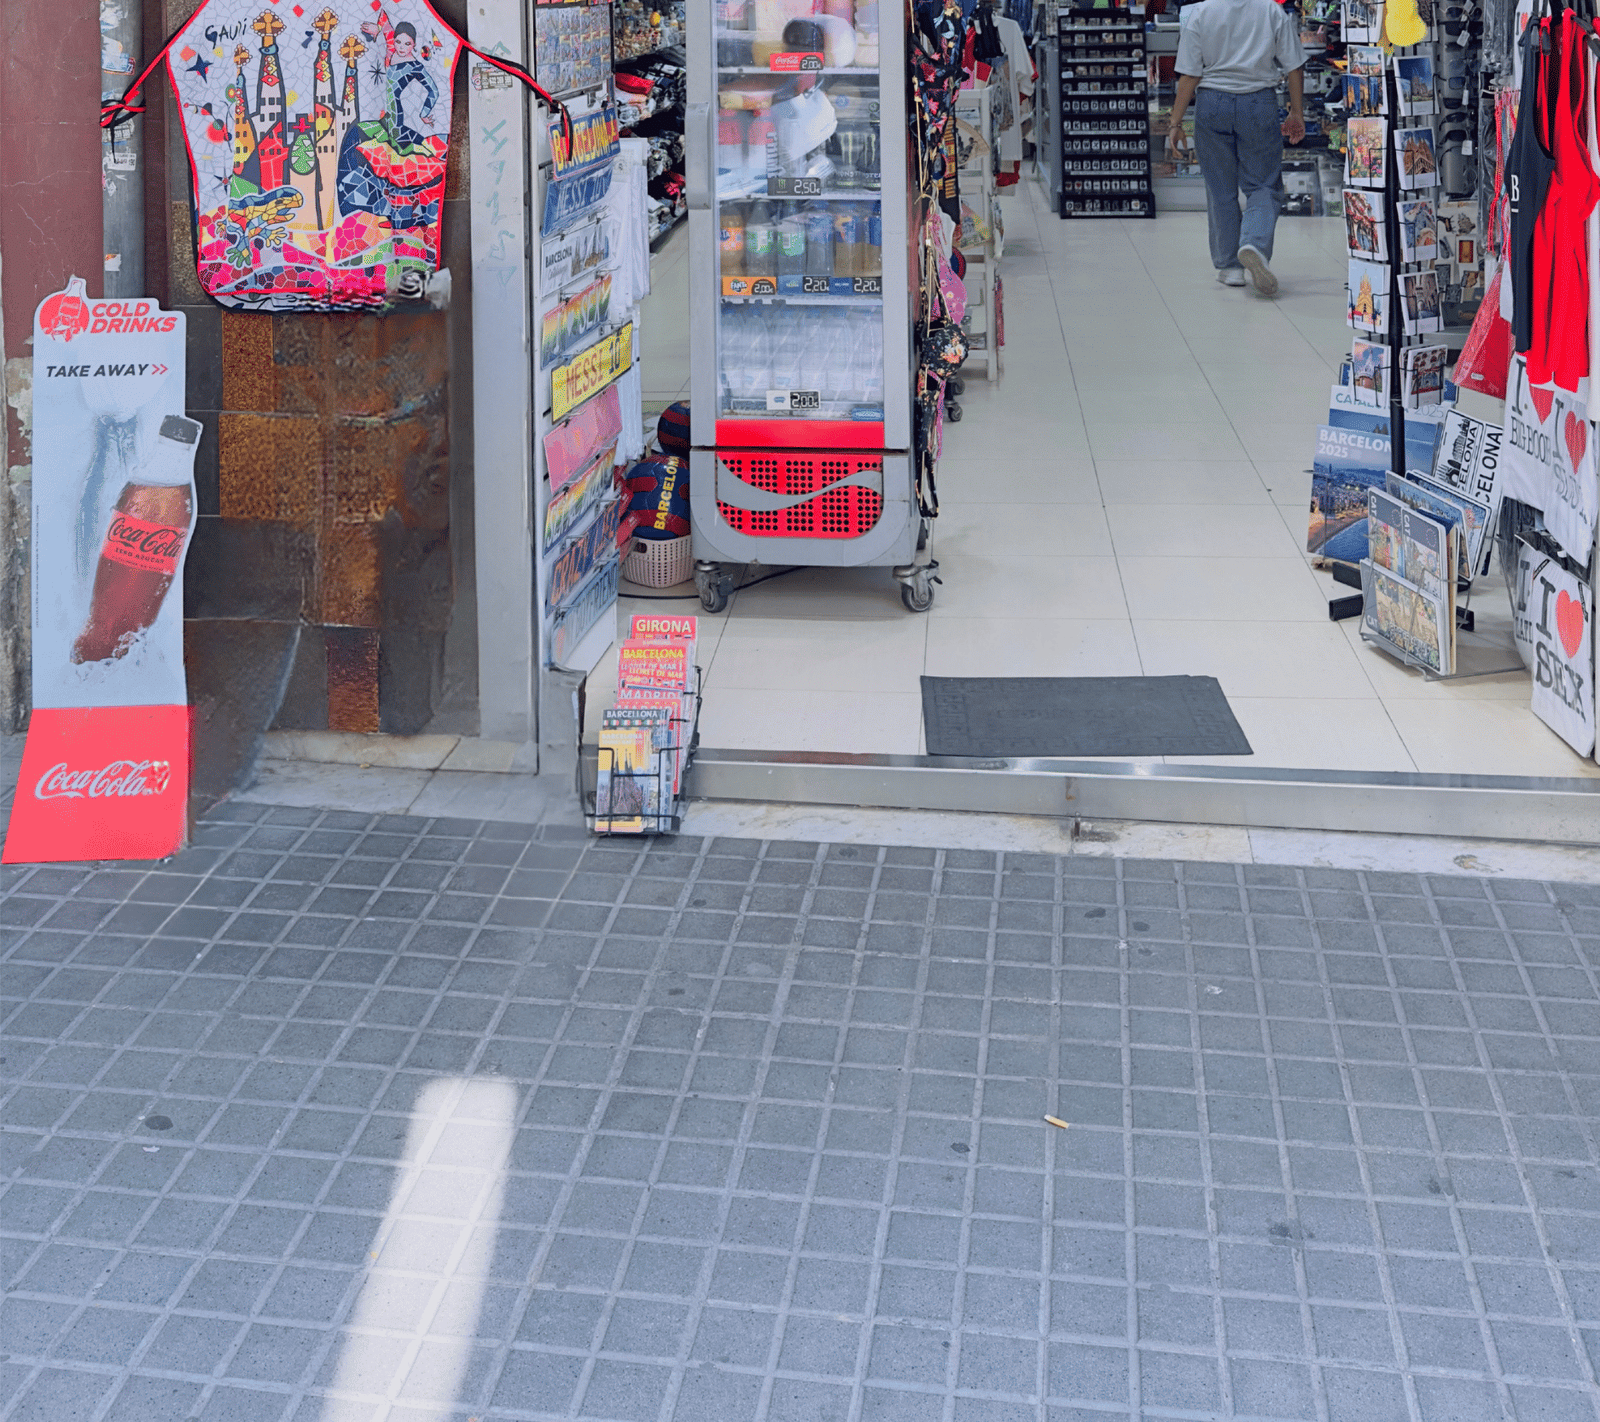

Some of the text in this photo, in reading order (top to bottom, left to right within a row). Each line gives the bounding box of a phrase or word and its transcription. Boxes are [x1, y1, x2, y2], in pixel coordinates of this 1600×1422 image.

[544, 245, 573, 269] BARCELONA
[91, 302, 150, 318] COLD
[89, 317, 178, 334] DRINKS
[46, 363, 149, 378] TAKE AWAY
[565, 349, 604, 404] MESSI
[1414, 404, 1444, 419] 2025
[1318, 444, 1354, 459] 2025
[1319, 428, 1392, 454] BARCELON
[1370, 495, 1378, 517] CAT
[1403, 514, 1412, 536] CAT
[107, 517, 187, 558] Coca-Cola
[1535, 575, 1557, 641] I
[636, 619, 692, 633] GIRONA
[623, 648, 684, 659] BARCELONA
[1535, 640, 1588, 724] SEX
[34, 759, 152, 800] Coca-Cola
